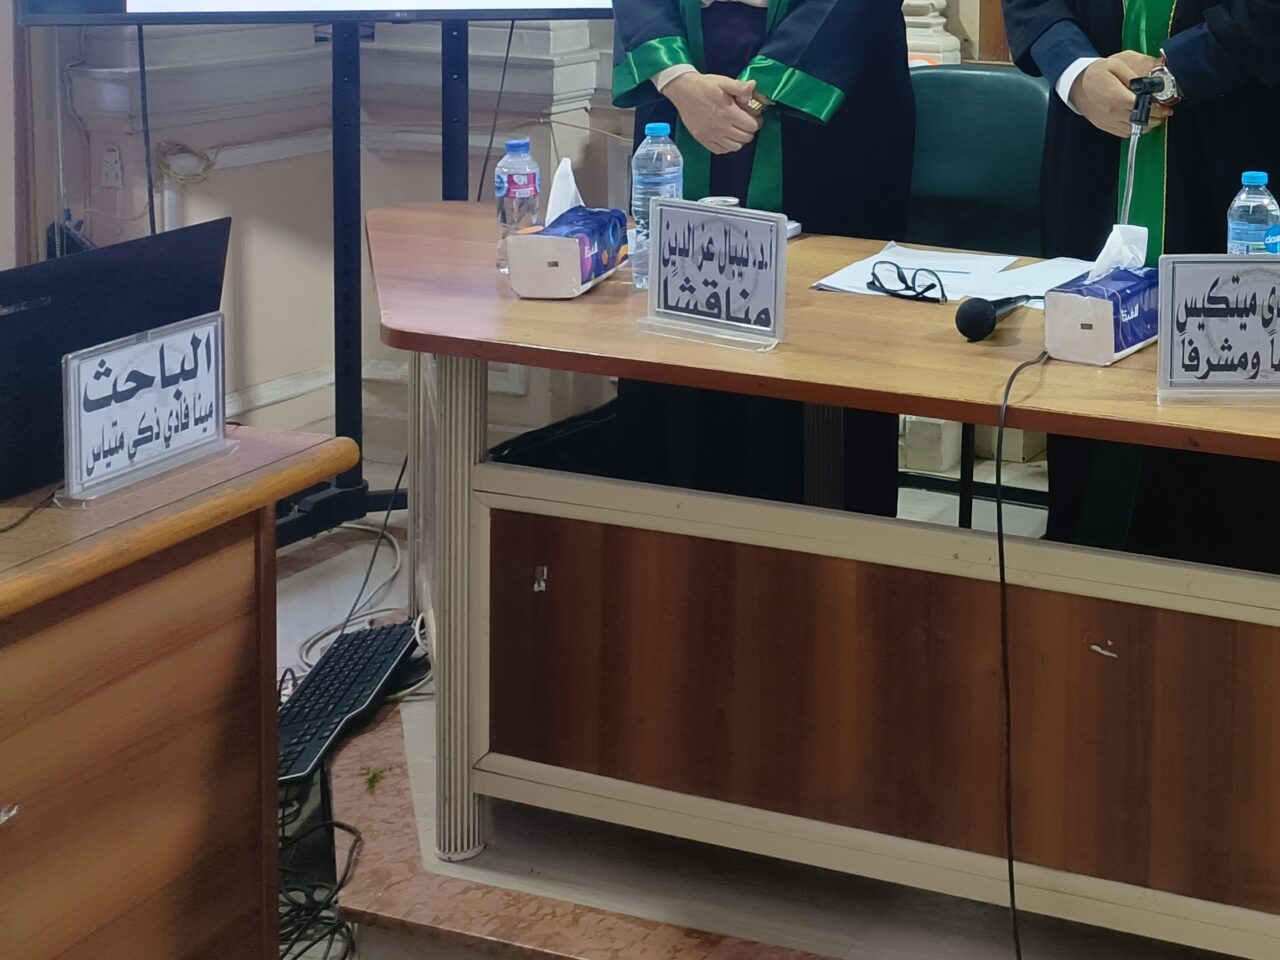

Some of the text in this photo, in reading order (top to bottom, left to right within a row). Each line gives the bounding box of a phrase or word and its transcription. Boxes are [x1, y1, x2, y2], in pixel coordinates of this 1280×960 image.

[662, 220, 695, 269] الدين
[696, 222, 715, 272] عز
[83, 331, 212, 413] الباحث
[86, 392, 213, 477] مينا فادي ذكي متياس
